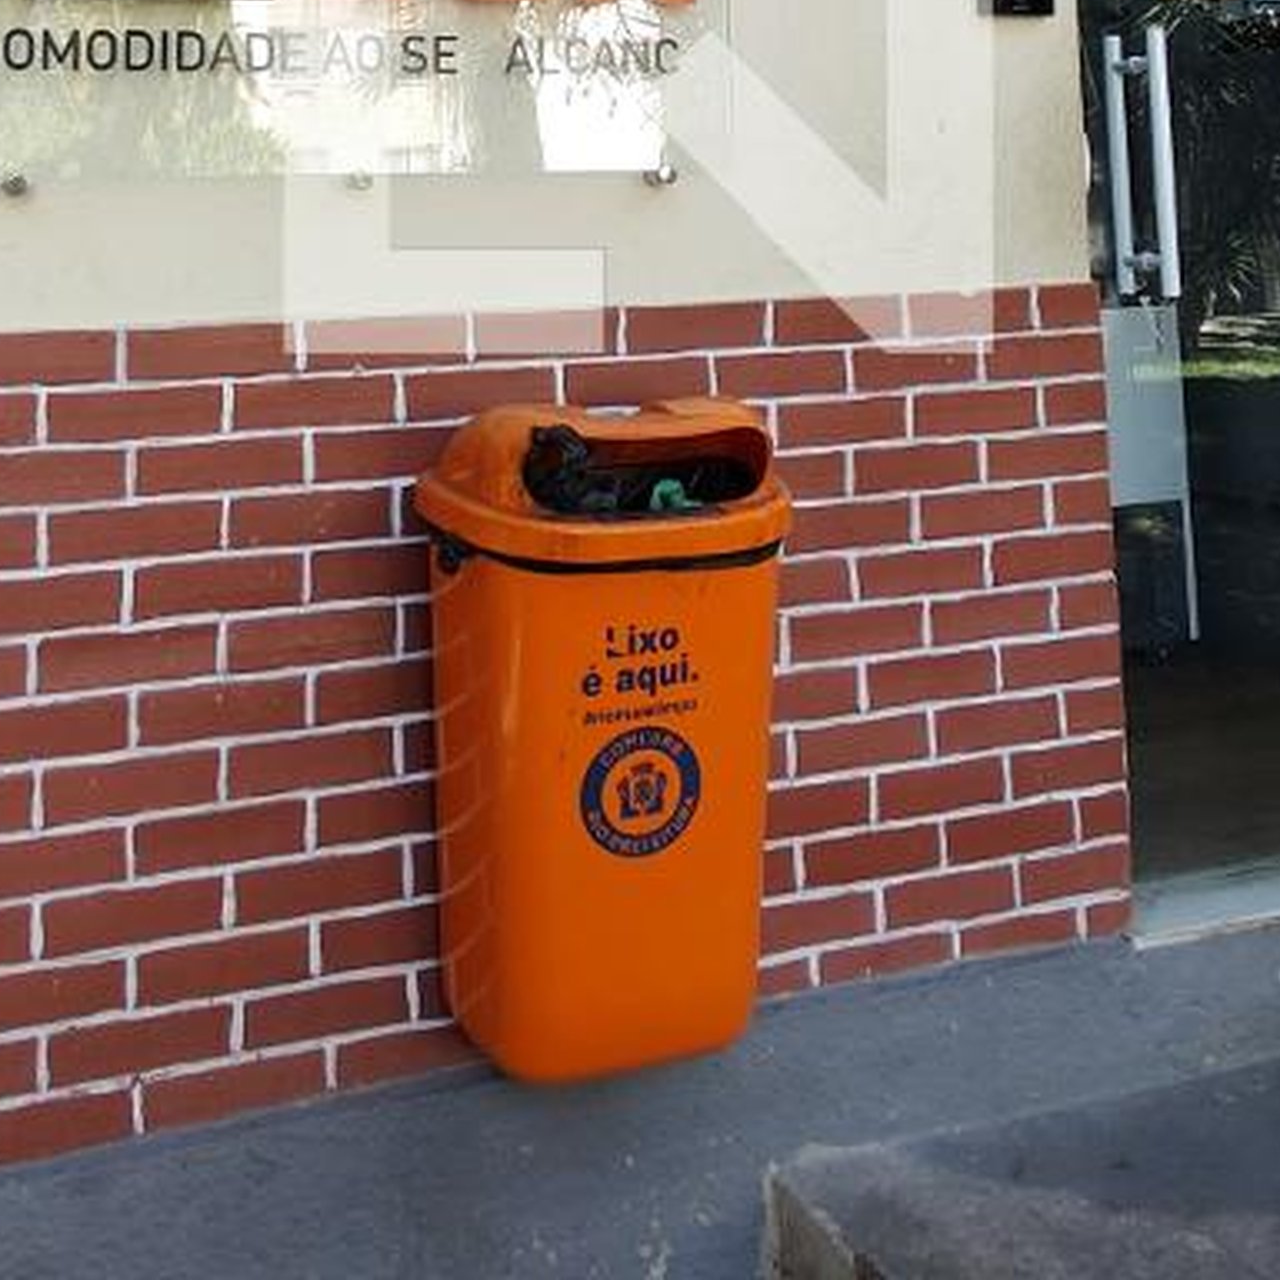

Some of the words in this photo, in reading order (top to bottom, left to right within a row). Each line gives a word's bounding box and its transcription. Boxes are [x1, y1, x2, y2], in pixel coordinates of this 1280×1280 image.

[605, 624, 680, 658] Lixo
[582, 666, 602, 697] é
[616, 653, 699, 697] aqui.
